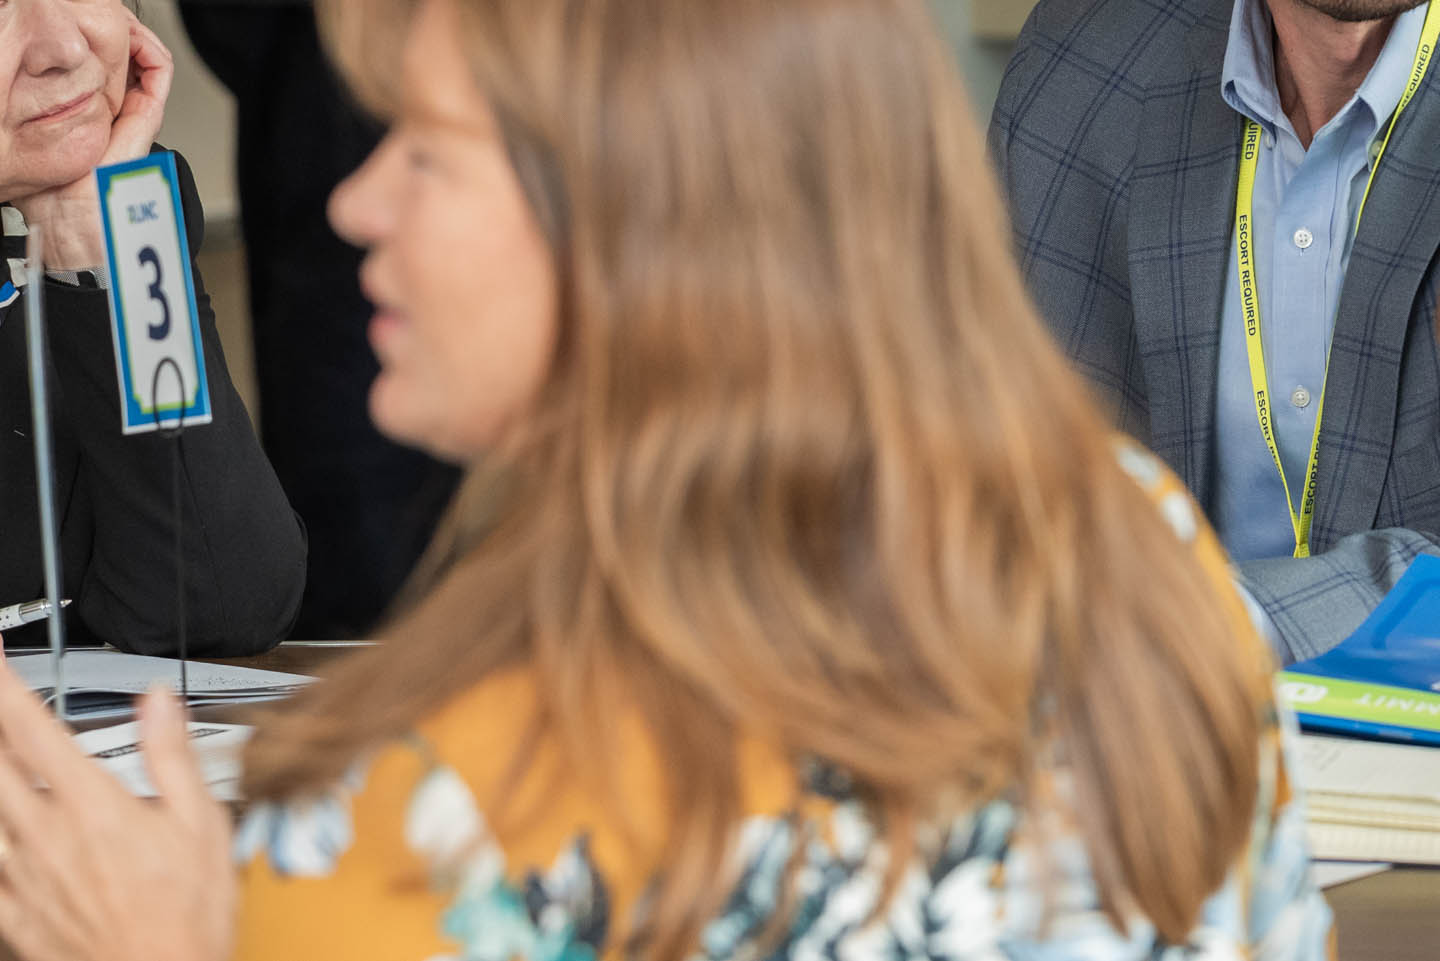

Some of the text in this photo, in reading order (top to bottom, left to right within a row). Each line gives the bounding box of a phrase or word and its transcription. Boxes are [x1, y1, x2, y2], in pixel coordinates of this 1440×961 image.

[1244, 120, 1259, 160] UIRED
[138, 246, 171, 341] 3
[1239, 214, 1256, 337] ESCORT REQUIRED
[1256, 390, 1271, 444] ESCORT
